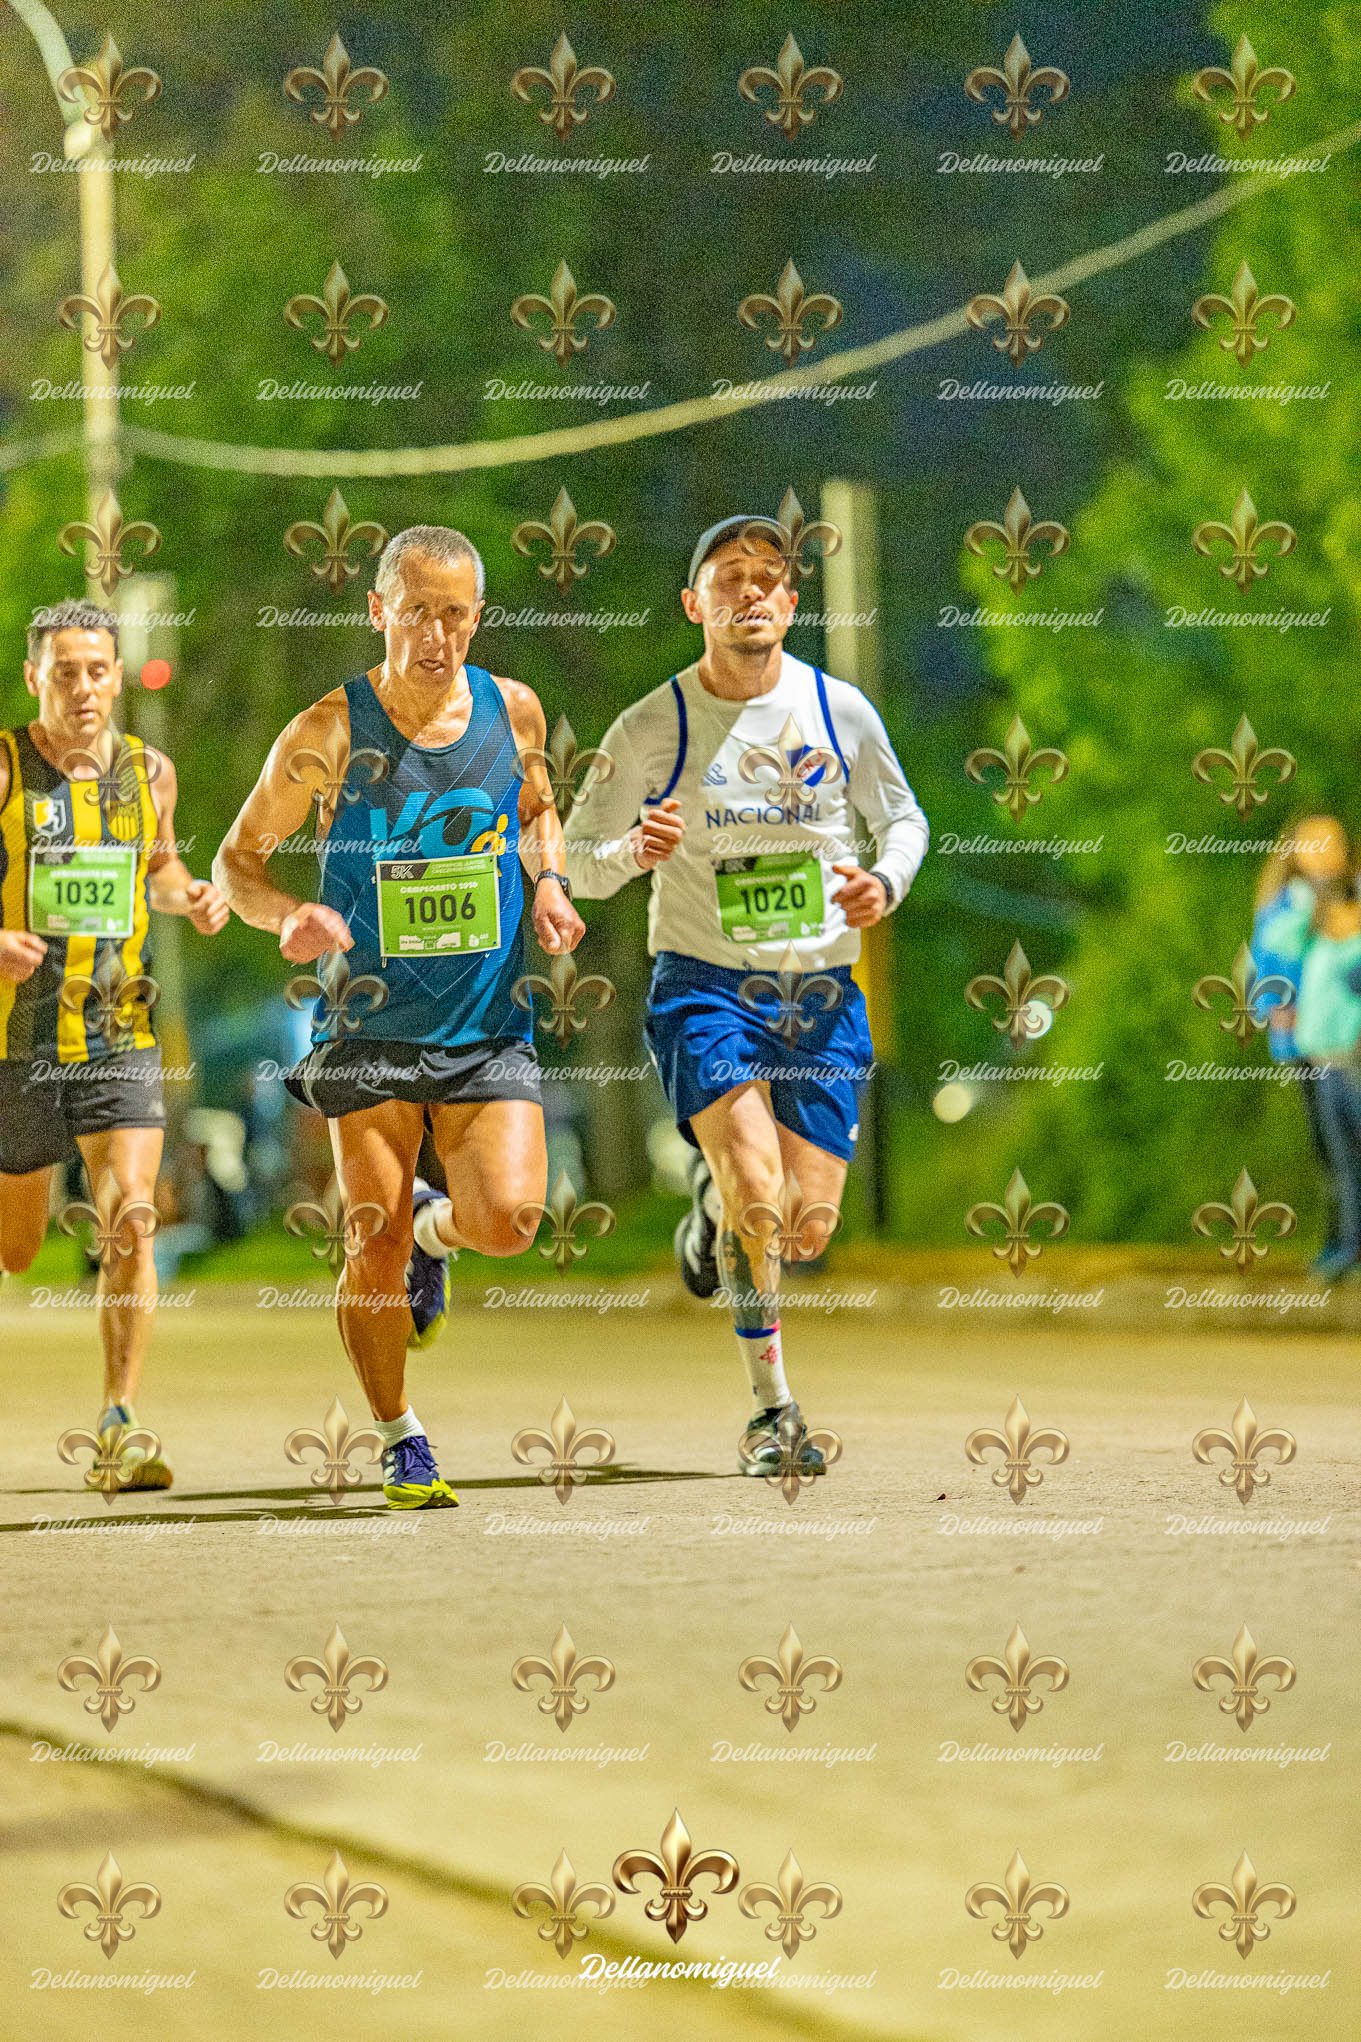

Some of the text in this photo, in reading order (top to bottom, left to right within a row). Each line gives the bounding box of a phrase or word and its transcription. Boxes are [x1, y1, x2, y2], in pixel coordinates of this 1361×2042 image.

[705, 803, 821, 829] NACIONAL
[391, 865, 415, 880] 5K
[54, 880, 115, 905] 1032
[740, 883, 806, 914] 1020
[405, 892, 476, 924] 1006
